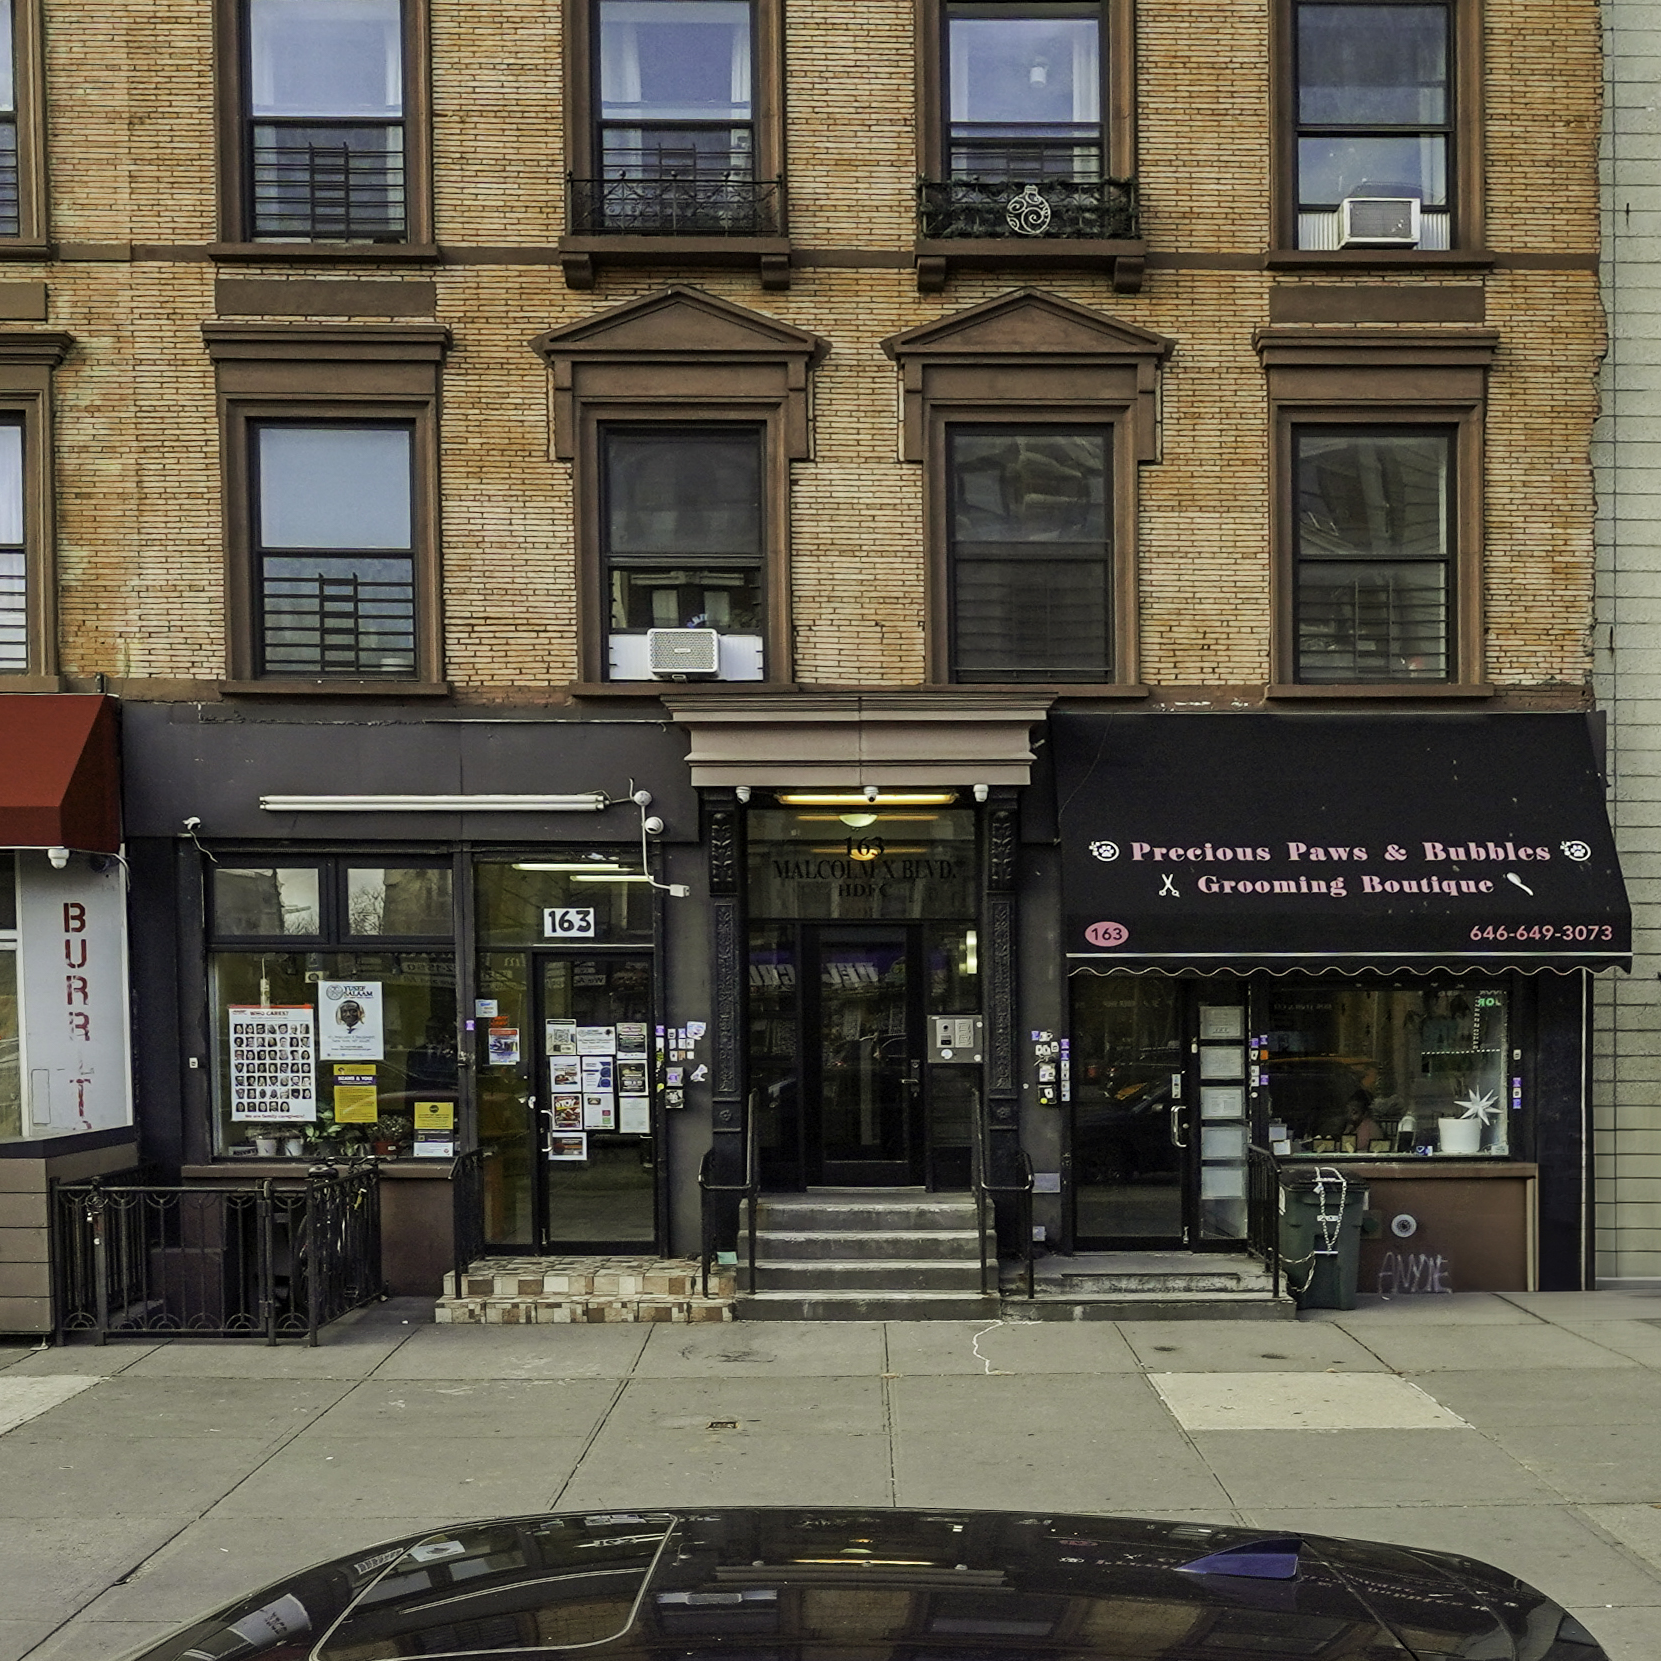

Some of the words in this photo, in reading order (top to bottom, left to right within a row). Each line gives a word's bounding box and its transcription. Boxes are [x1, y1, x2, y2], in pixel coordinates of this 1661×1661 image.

[844, 836, 885, 857] 163
[1130, 841, 1271, 861] Precious
[1286, 841, 1368, 861] Paws
[1384, 844, 1407, 861] &
[1422, 841, 1551, 861] Bubbles
[773, 860, 878, 879] MALCOLM
[881, 860, 898, 879] X
[902, 860, 957, 879] BLVD.
[838, 883, 892, 897] HDFC
[1197, 875, 1348, 898] Grooming
[1361, 875, 1494, 896] Boutique
[548, 909, 592, 933] 163
[1091, 927, 1123, 941] 163
[1469, 925, 1613, 941] 646-649-3073
